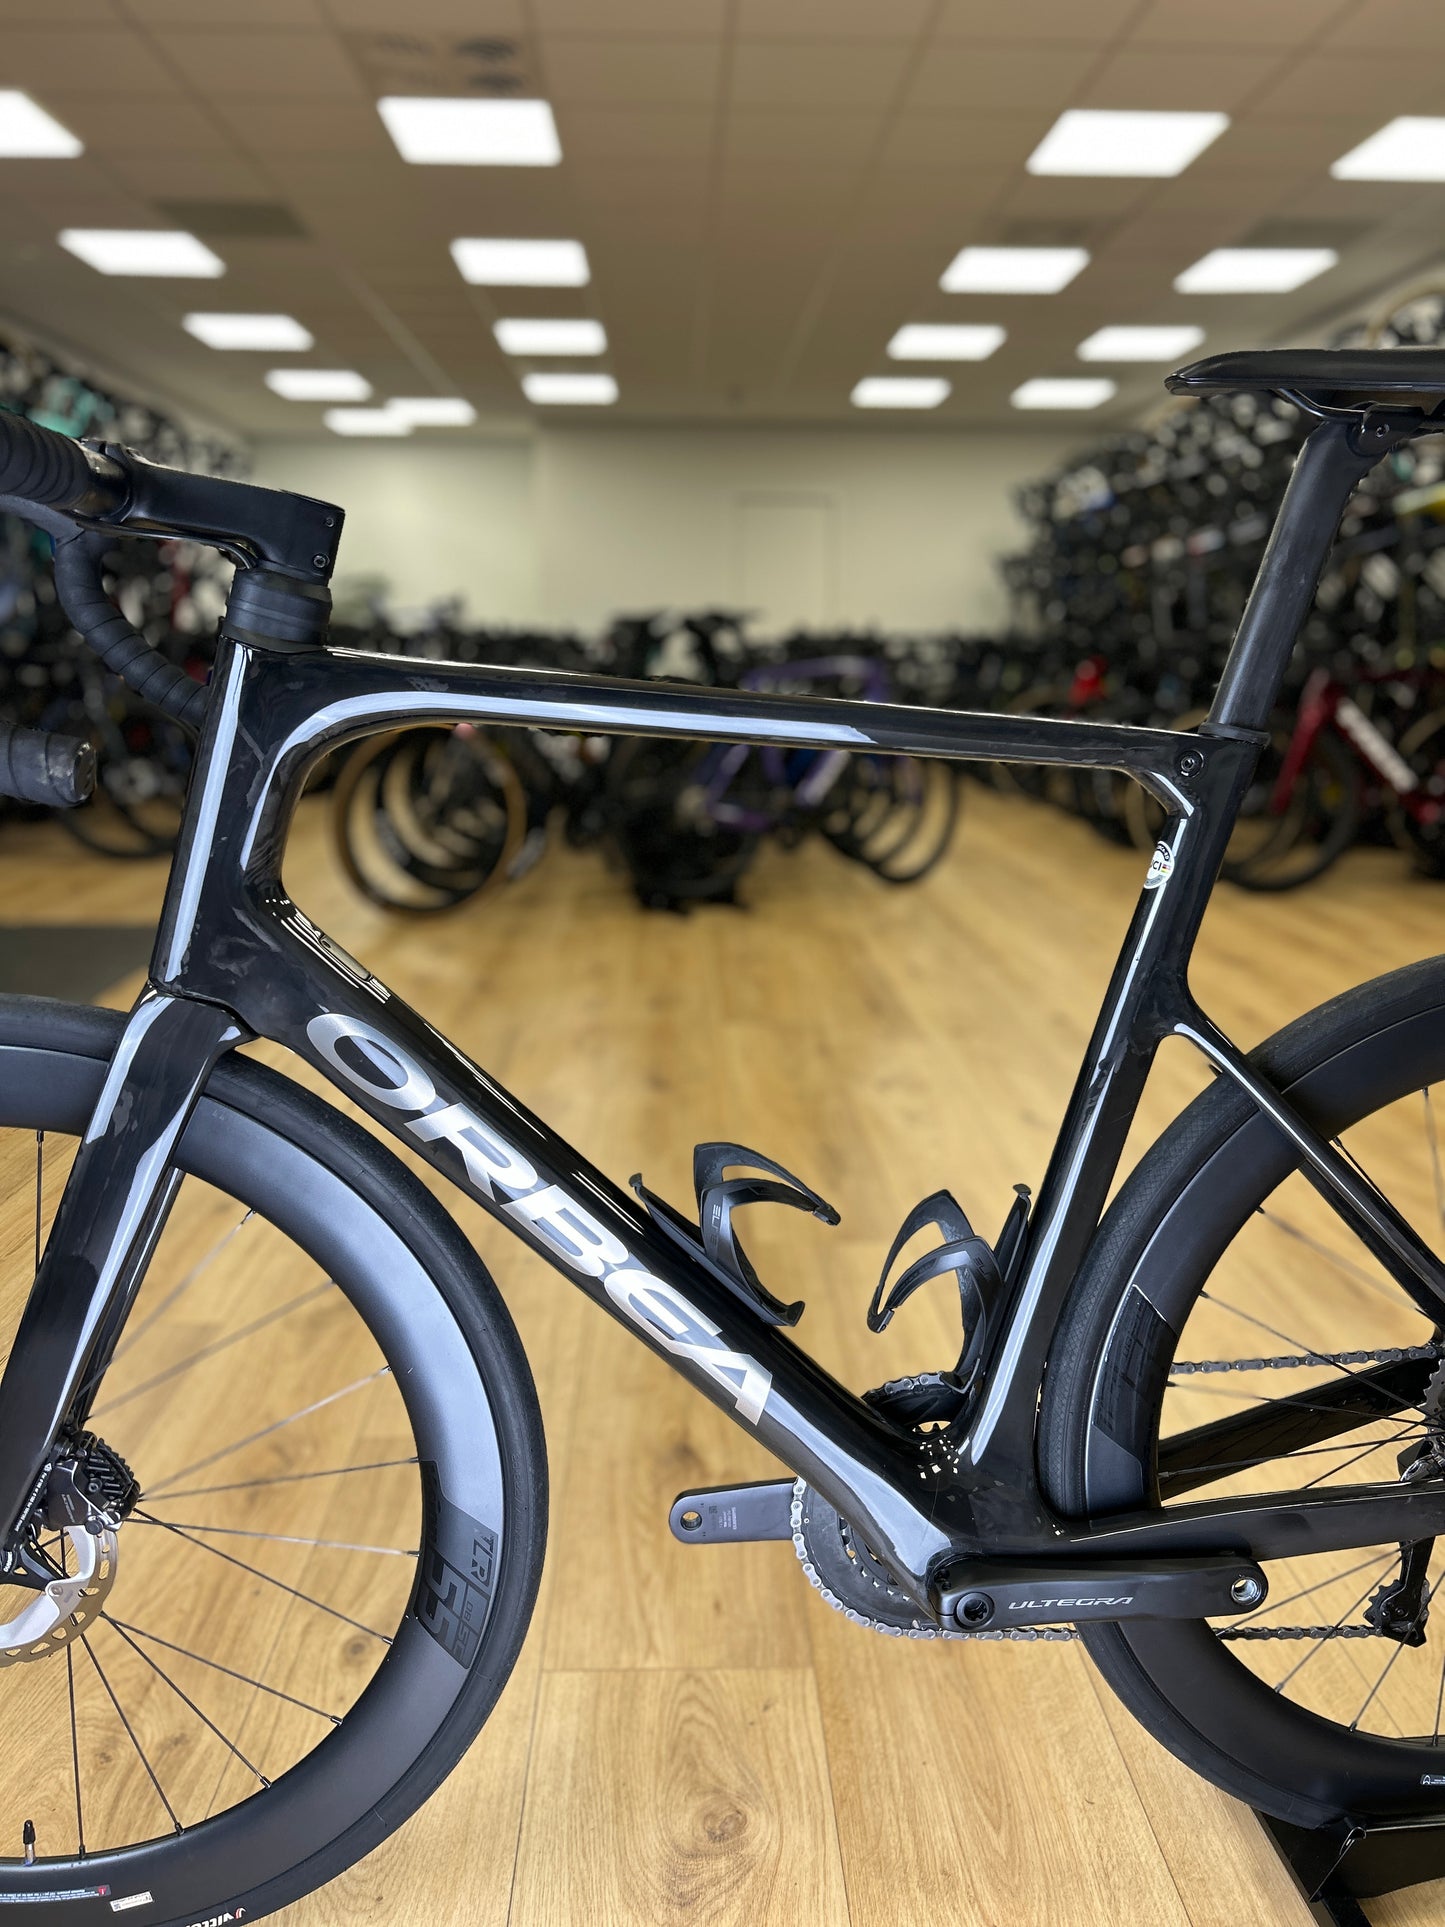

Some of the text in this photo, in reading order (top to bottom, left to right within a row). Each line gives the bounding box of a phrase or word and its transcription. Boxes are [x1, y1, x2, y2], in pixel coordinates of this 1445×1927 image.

[306, 1013, 773, 1426] ORBEA
[471, 1534, 495, 1587] TLR
[418, 1554, 467, 1650] 55
[1008, 1596, 1134, 1610] ULTEGRA
[186, 1911, 234, 1927] vitto
